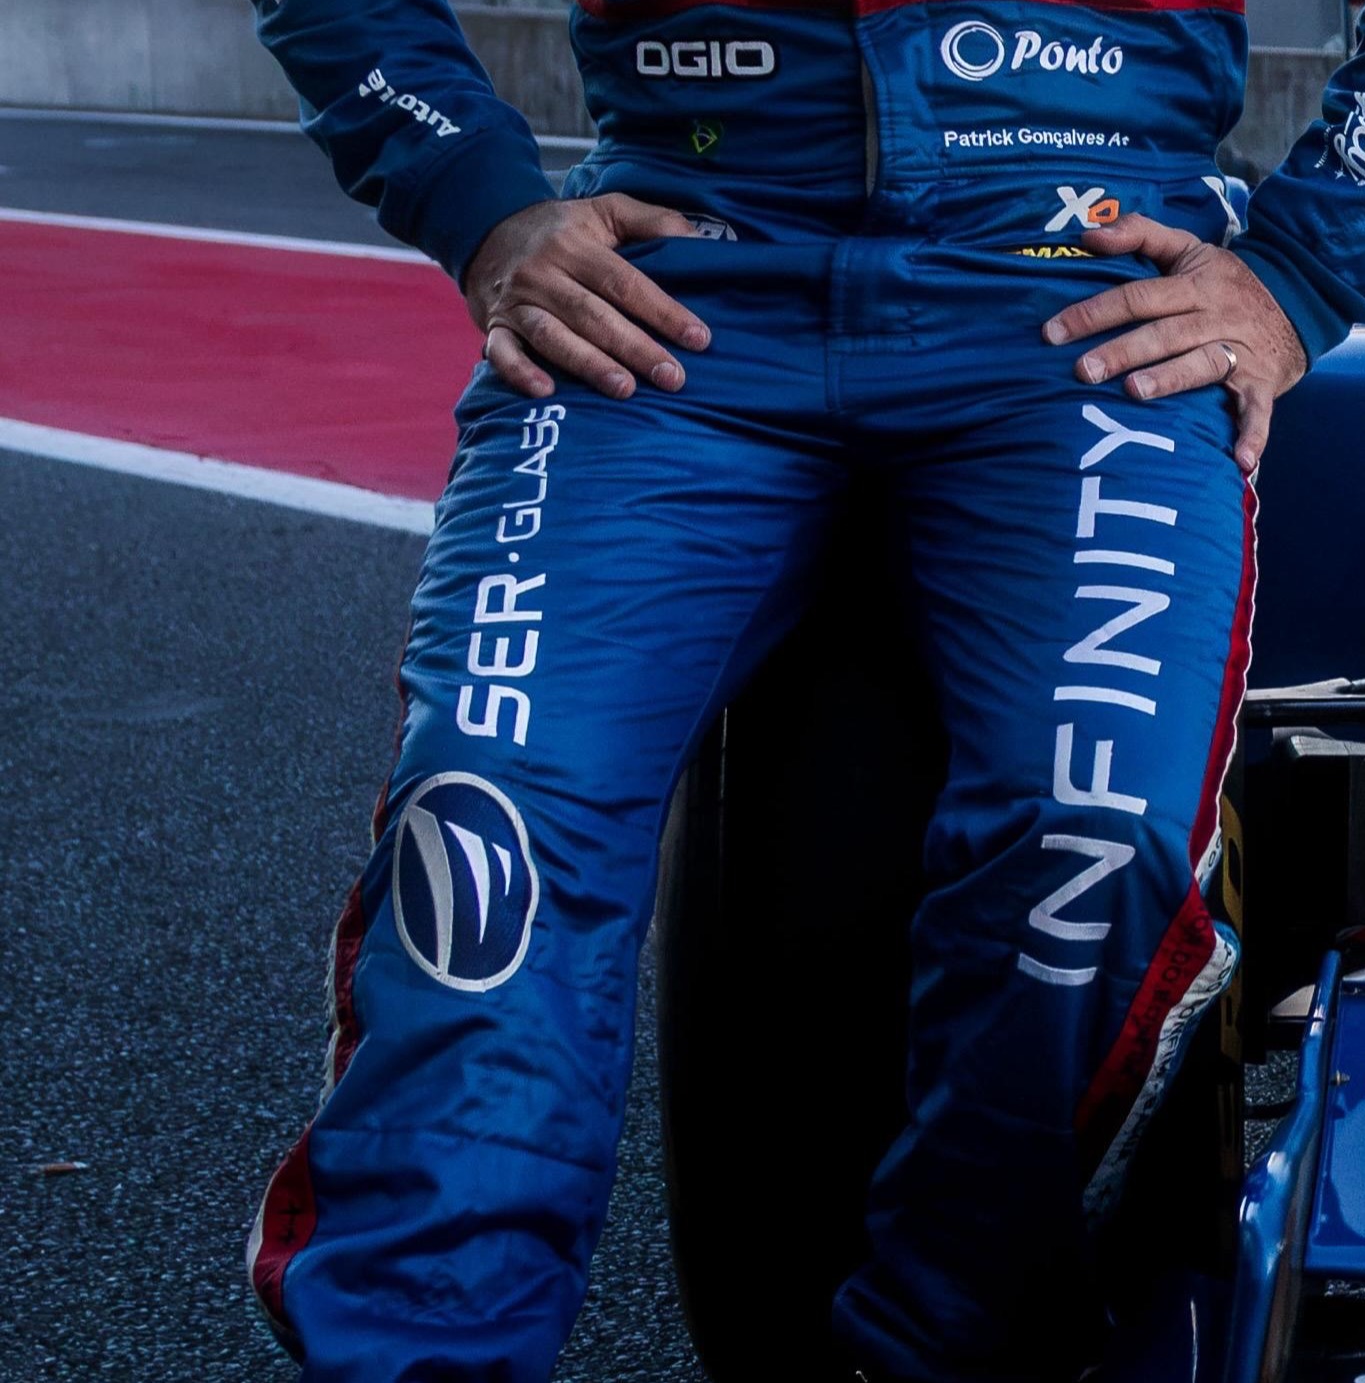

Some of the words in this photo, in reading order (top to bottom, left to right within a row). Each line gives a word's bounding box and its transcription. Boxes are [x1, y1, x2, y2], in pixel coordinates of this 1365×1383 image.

[636, 41, 775, 77] OGIO
[1011, 30, 1123, 75] Ponto
[944, 129, 1014, 148] Patrick
[1017, 127, 1105, 149] Gonçalves
[1017, 403, 1178, 985] INFINITY
